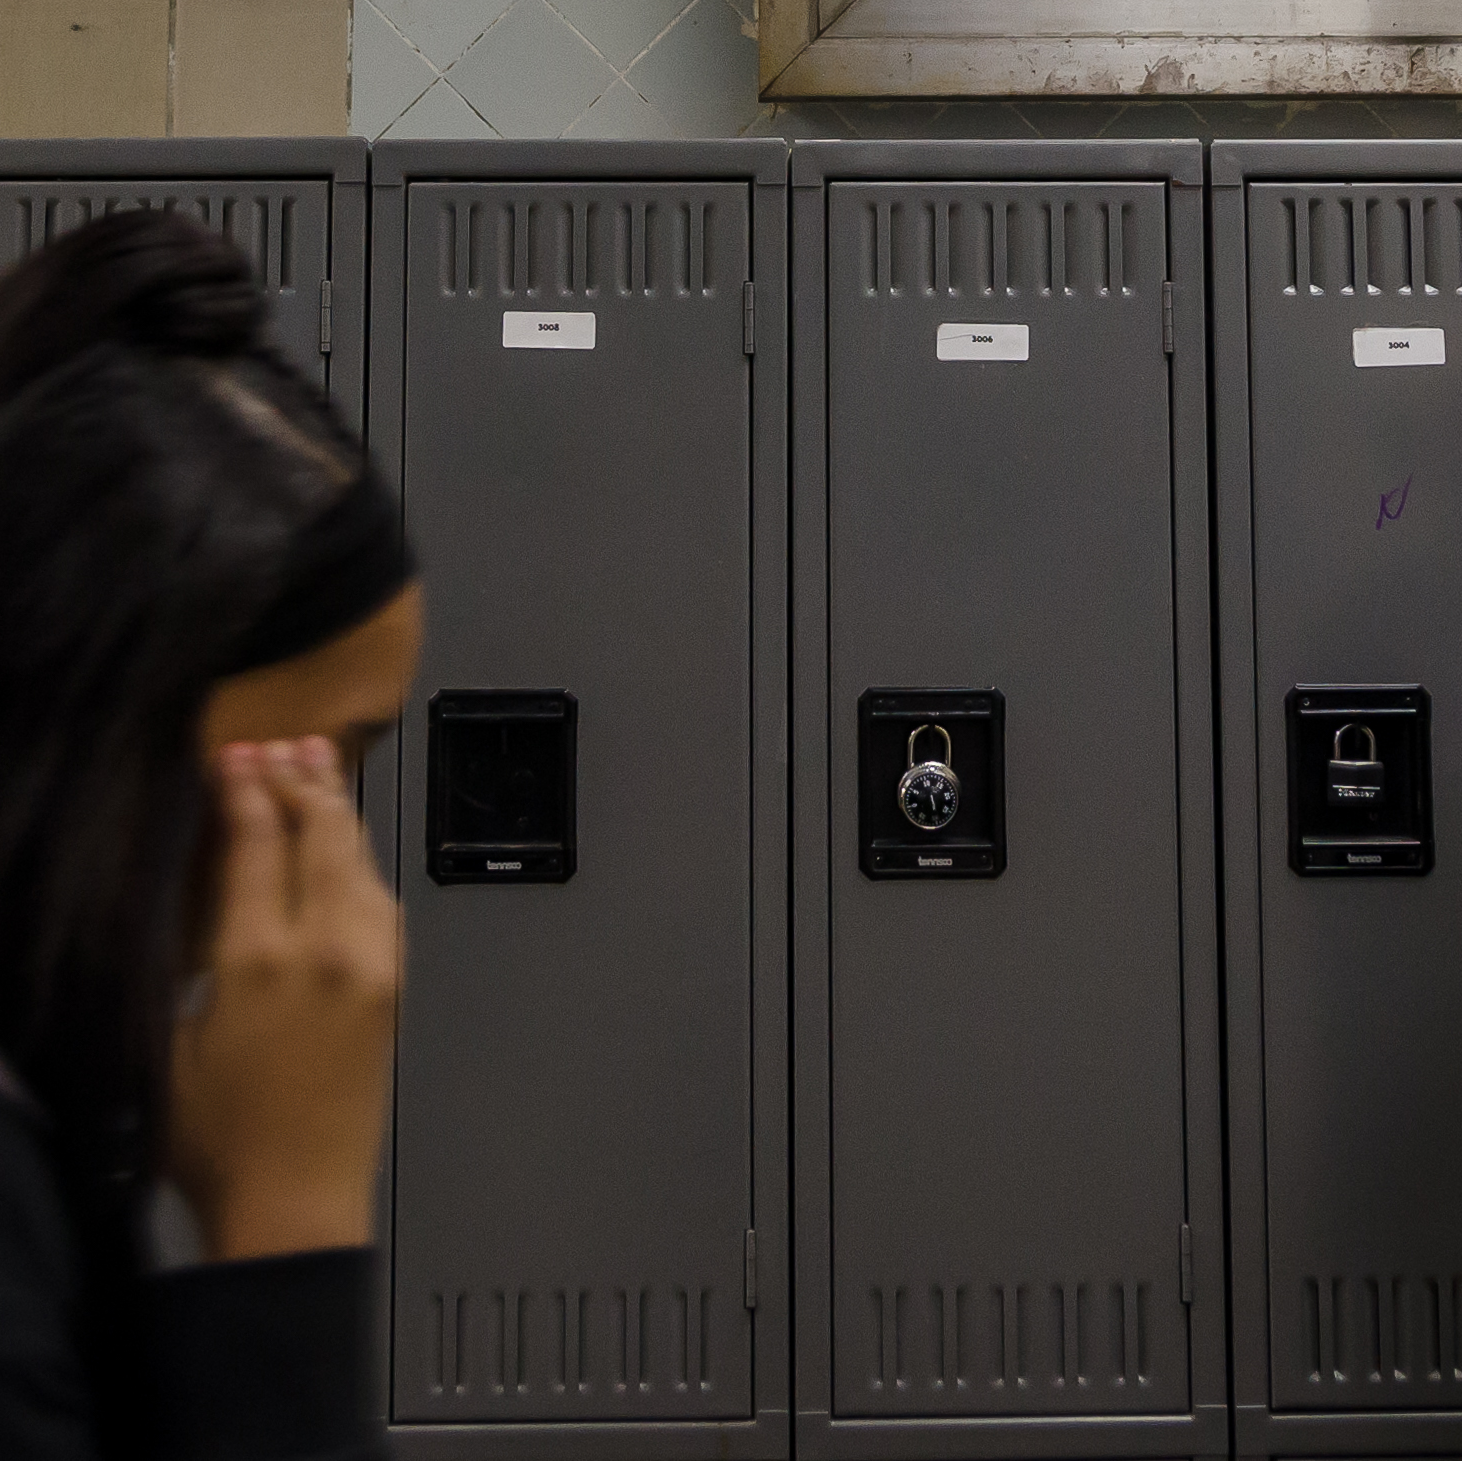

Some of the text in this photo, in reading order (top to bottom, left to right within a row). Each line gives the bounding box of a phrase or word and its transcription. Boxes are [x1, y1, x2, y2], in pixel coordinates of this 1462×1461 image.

[538, 323, 560, 331] 3008
[972, 335, 994, 344] 3006
[1388, 341, 1410, 349] 3004
